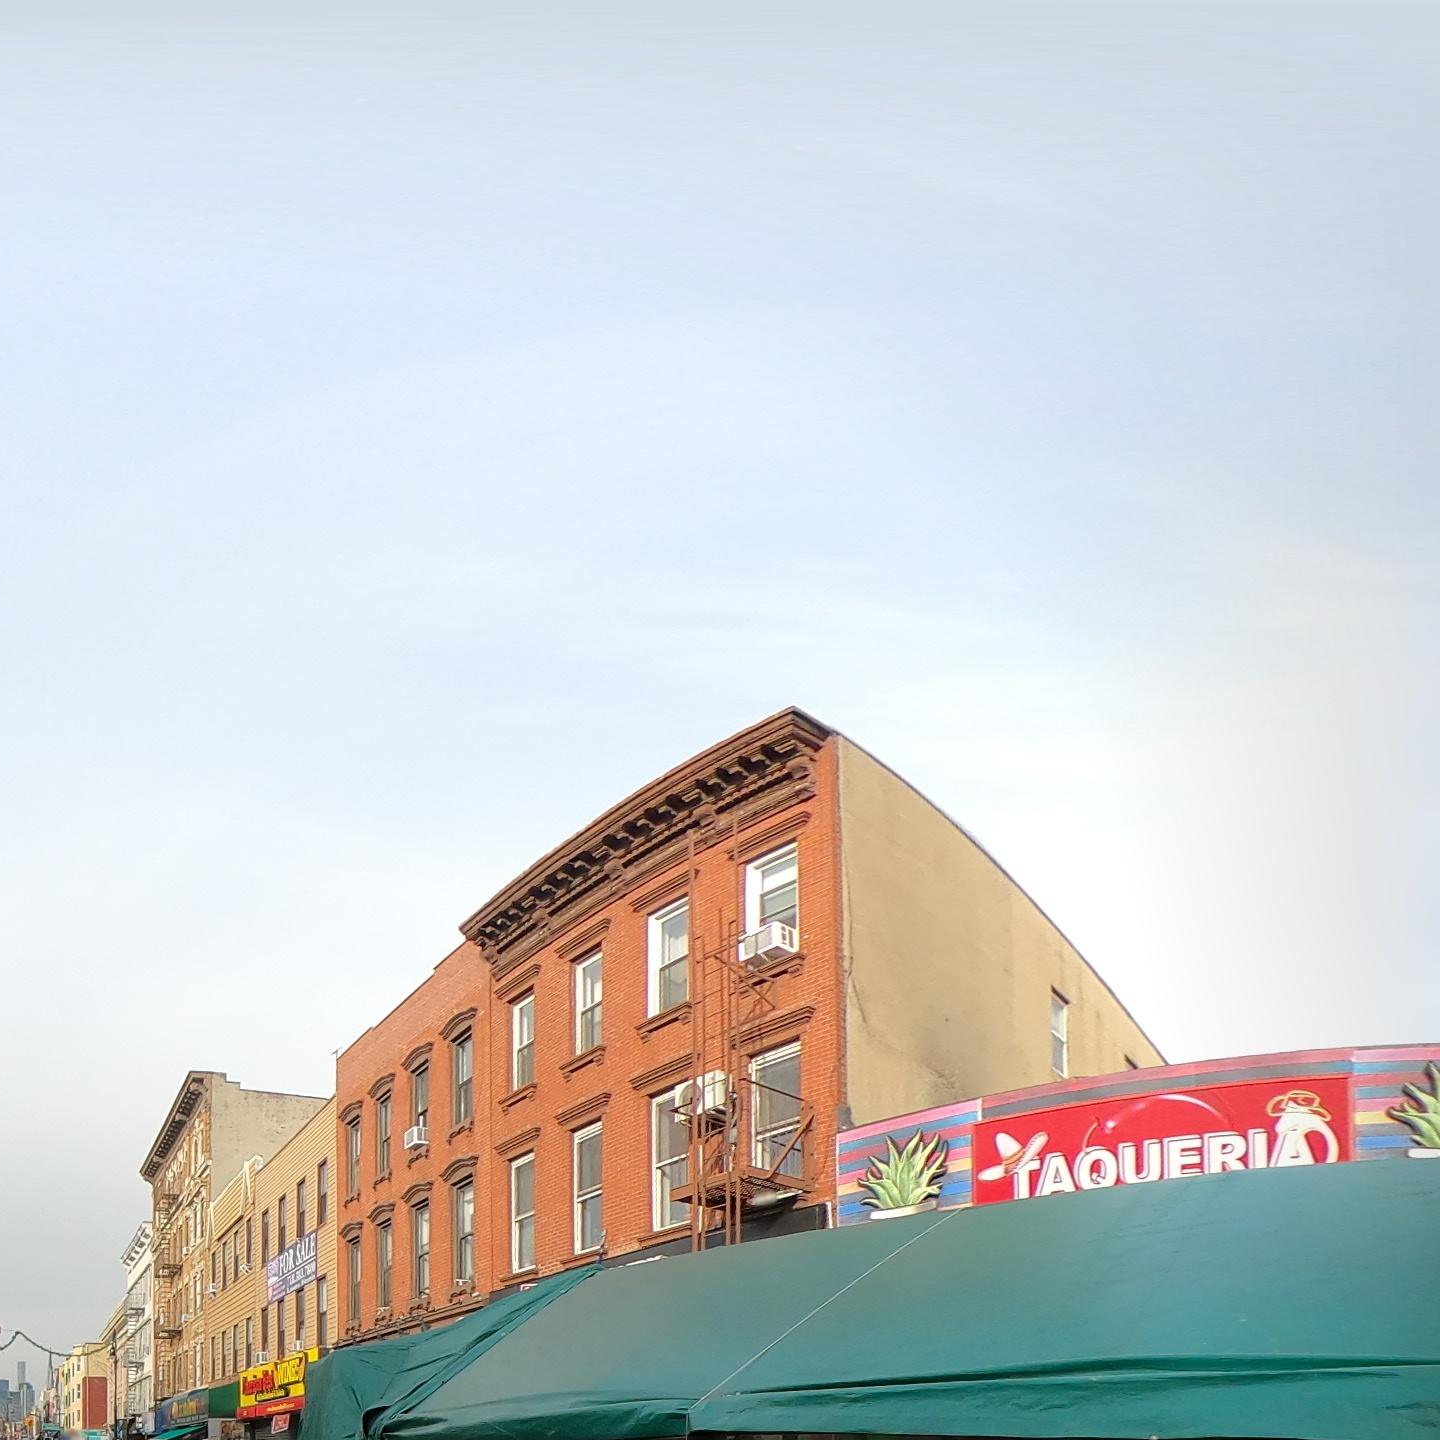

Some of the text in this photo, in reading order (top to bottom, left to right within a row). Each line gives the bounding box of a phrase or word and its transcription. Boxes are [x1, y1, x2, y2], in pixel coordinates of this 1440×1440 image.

[1012, 1125, 1320, 1201] TAQUERIA
[279, 1248, 295, 1277] FOR
[296, 1232, 316, 1266] SALE
